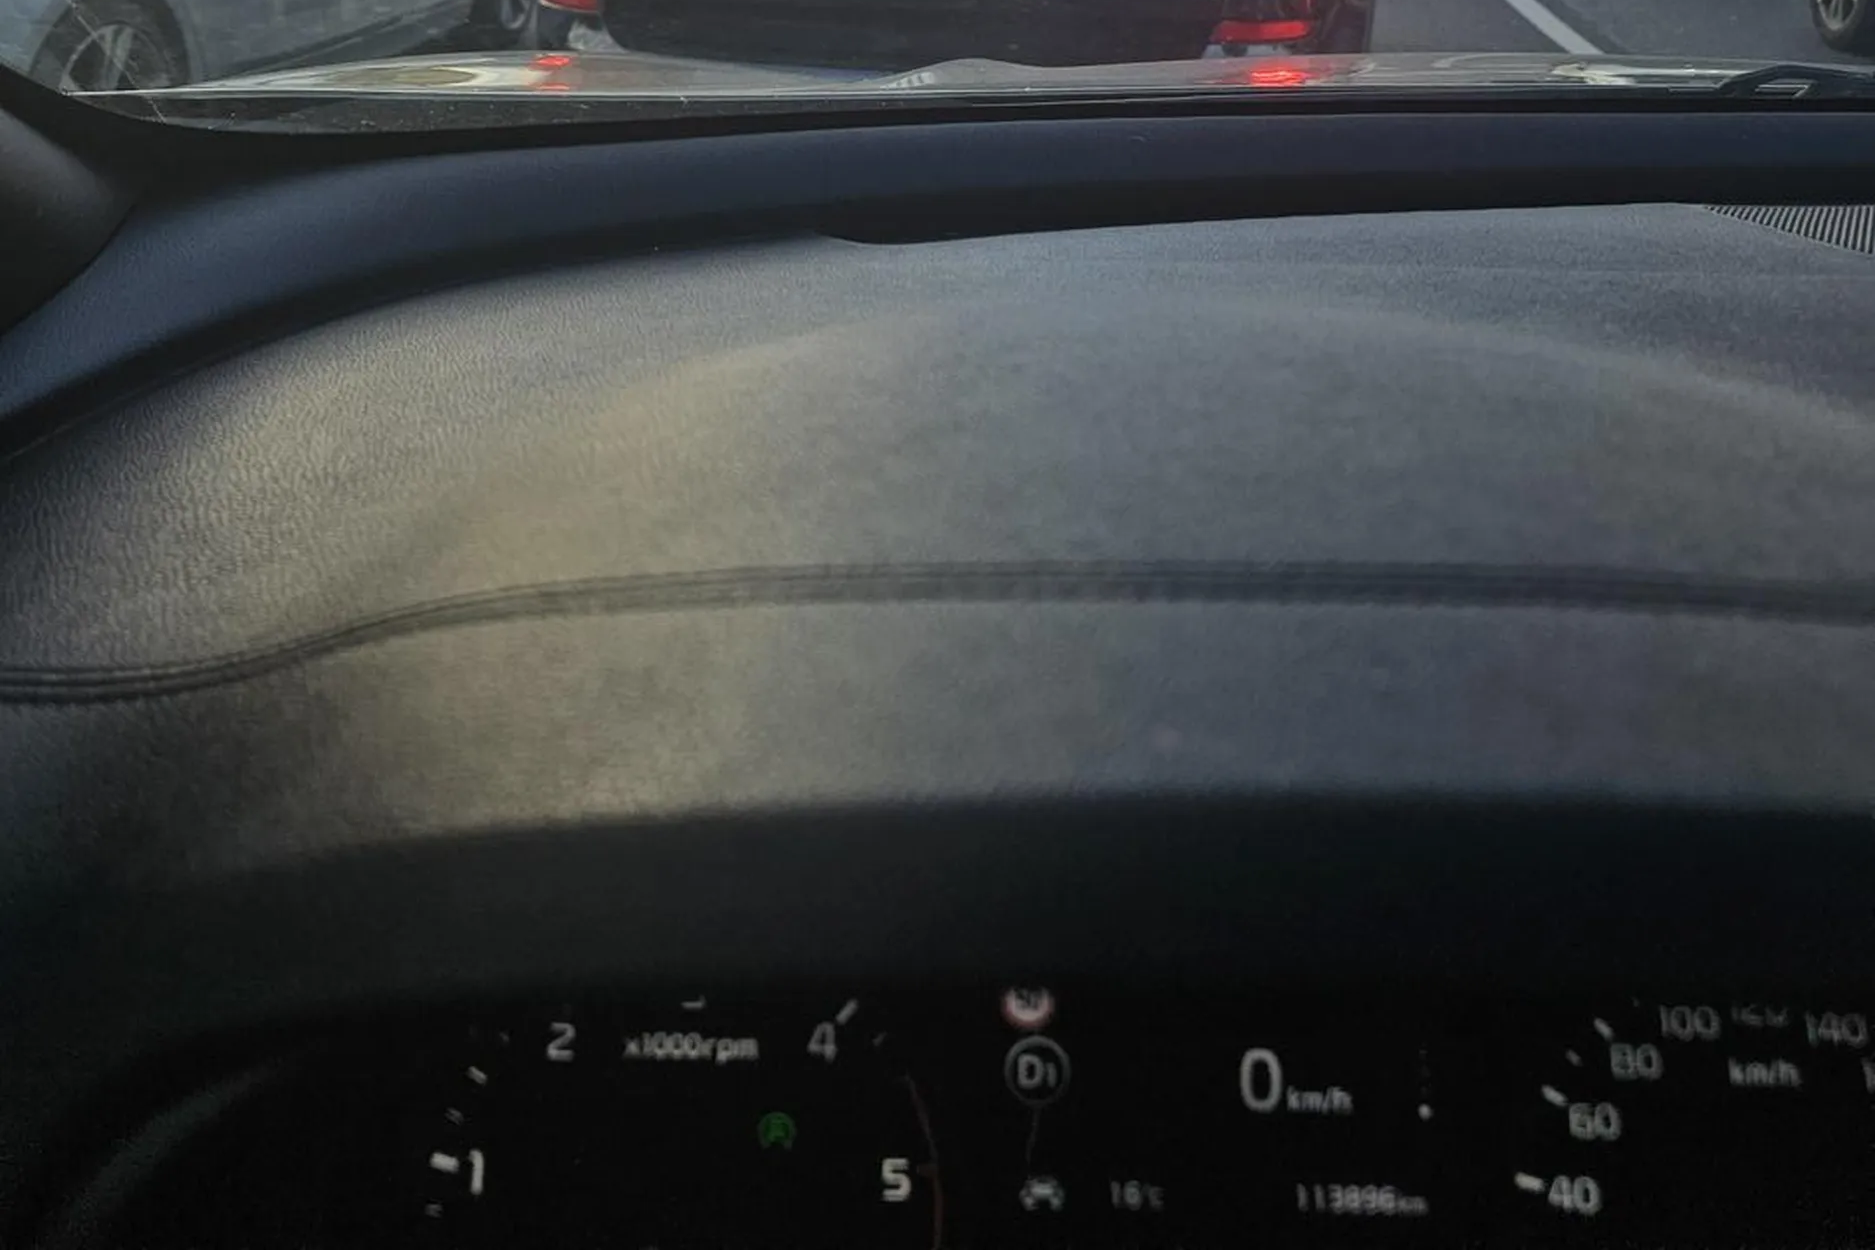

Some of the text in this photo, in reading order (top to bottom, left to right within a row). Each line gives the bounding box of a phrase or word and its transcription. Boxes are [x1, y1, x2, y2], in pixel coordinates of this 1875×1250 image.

[546, 1021, 576, 1061] 2
[807, 1022, 838, 1062] 4
[1660, 1004, 1721, 1041] 100
[1805, 1010, 1869, 1048] 140
[1239, 1047, 1354, 1114] 0 km/h
[1611, 1043, 1663, 1080] 80
[1728, 1057, 1802, 1088] km/h
[1569, 1102, 1622, 1141] 60
[468, 1149, 486, 1195] 1
[881, 1157, 912, 1202] 5
[1548, 1175, 1602, 1216] 40
